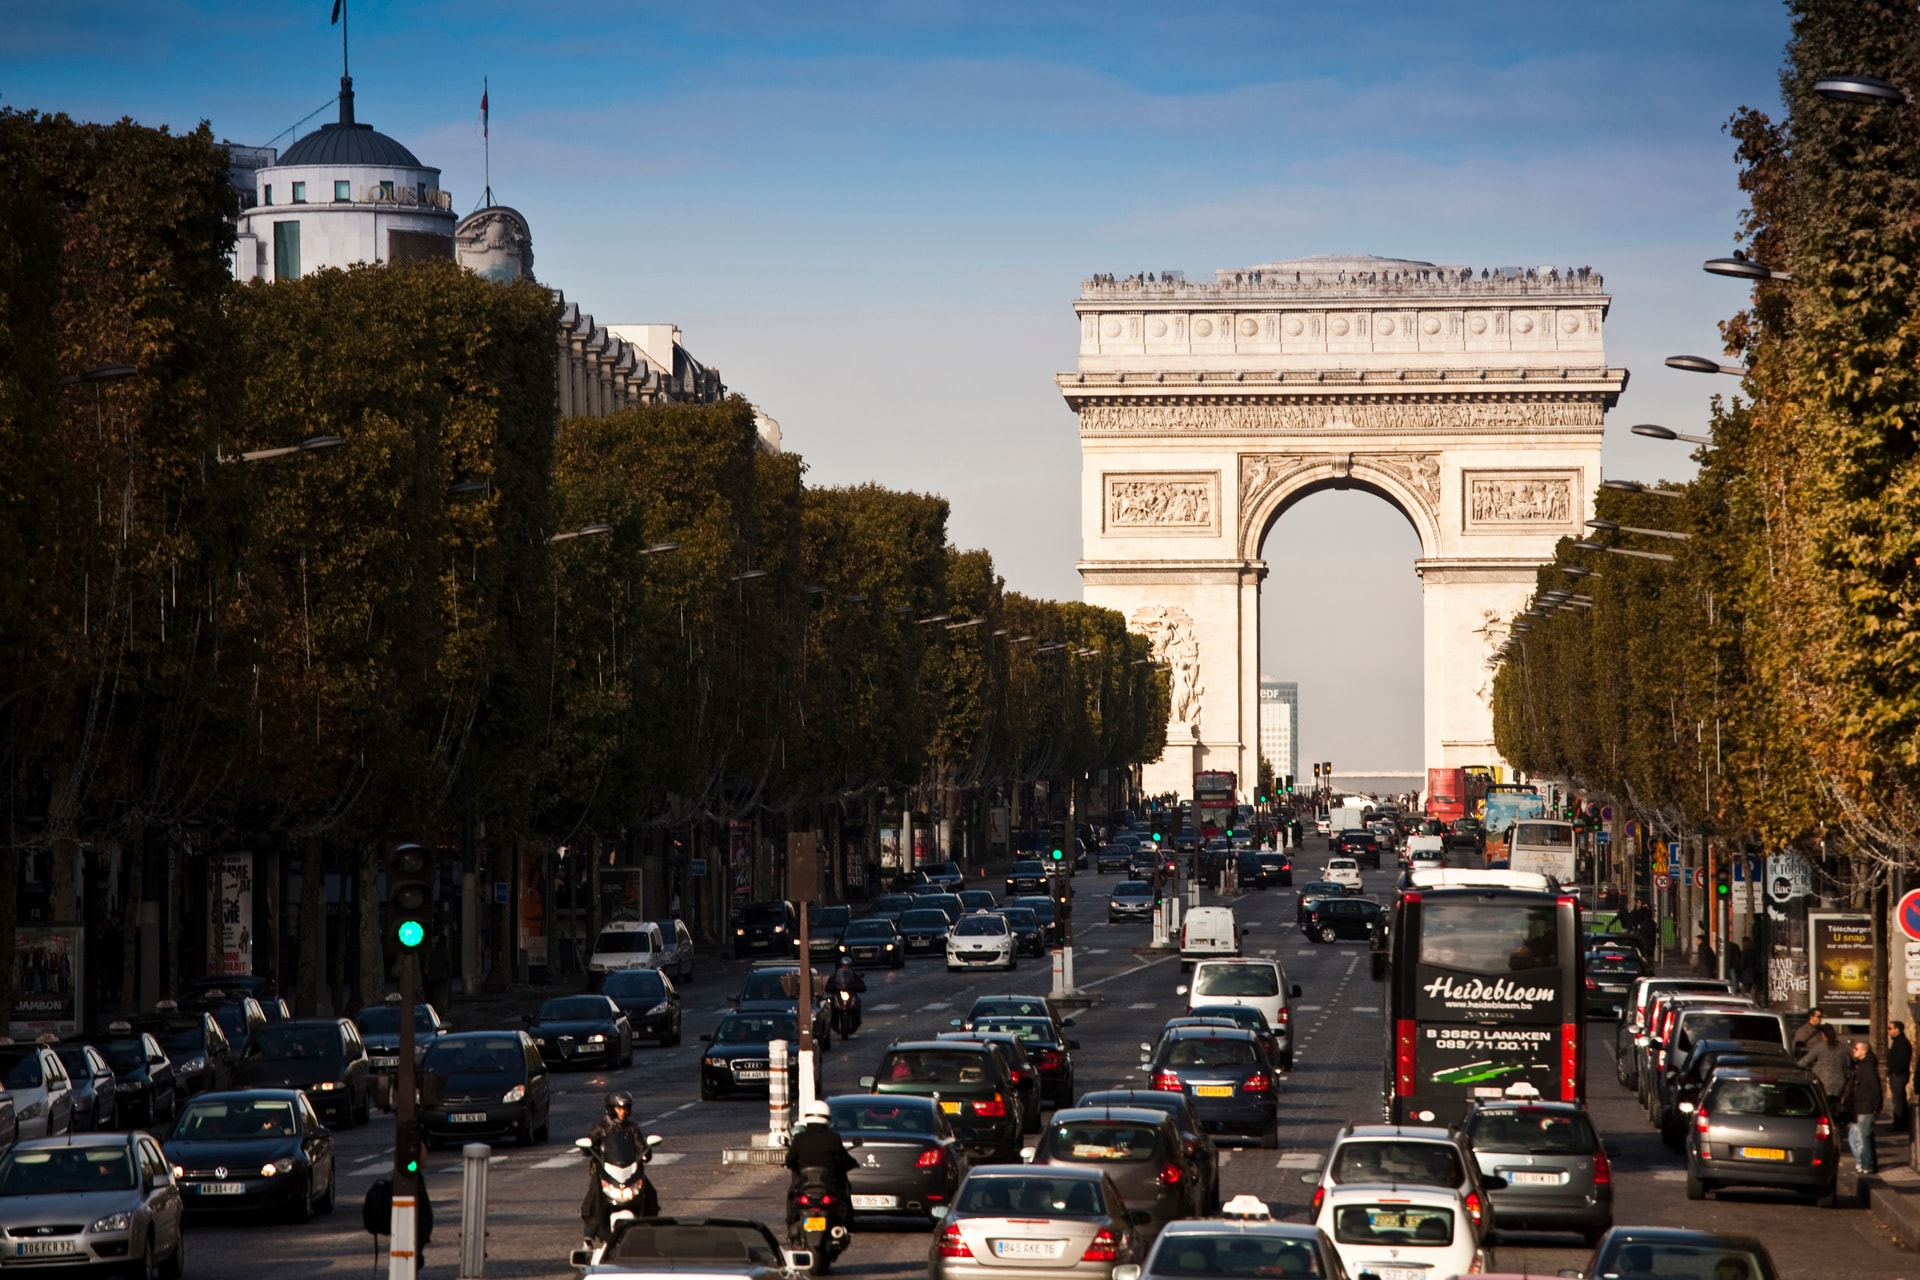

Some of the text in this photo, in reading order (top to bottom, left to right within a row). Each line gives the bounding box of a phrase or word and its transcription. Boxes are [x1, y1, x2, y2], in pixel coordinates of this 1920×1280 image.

[360, 184, 418, 206] LOUIS
[1659, 878, 1668, 886] 30
[1833, 933, 1866, 943] U snap
[1423, 976, 1555, 1002] Heidebloem
[1445, 1001, 1532, 1010] www.heidebloem.be
[1427, 1030, 1551, 1041] B 3620 LANAKEN
[1436, 1040, 1538, 1051] 089/71.00.11
